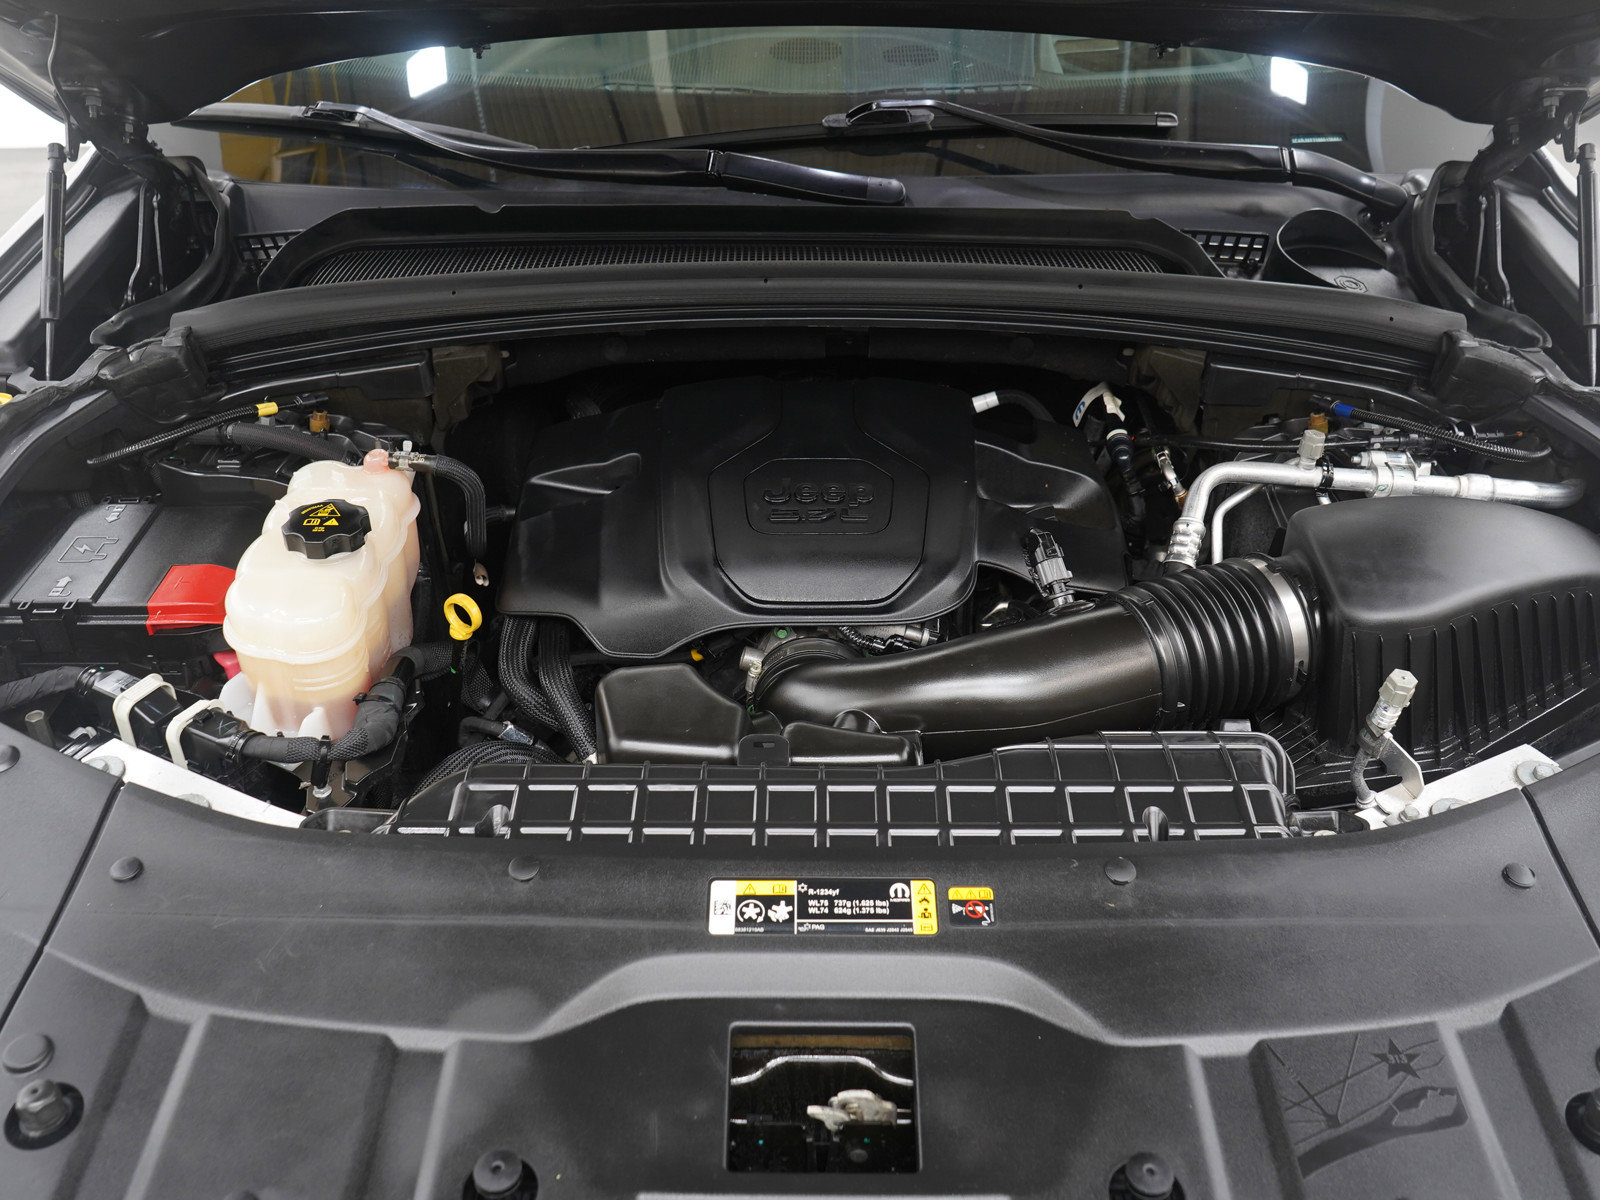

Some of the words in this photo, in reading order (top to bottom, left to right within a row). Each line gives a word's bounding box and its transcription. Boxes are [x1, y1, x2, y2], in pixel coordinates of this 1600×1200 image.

[763, 478, 875, 508] Jeep
[769, 507, 869, 524] 5.7L
[808, 888, 839, 897] R-1234yf
[834, 899, 852, 908] 737g
[875, 899, 890, 907] lbs)
[834, 907, 852, 915] 624g
[852, 907, 874, 915] (1.375
[875, 907, 890, 915] lbs)
